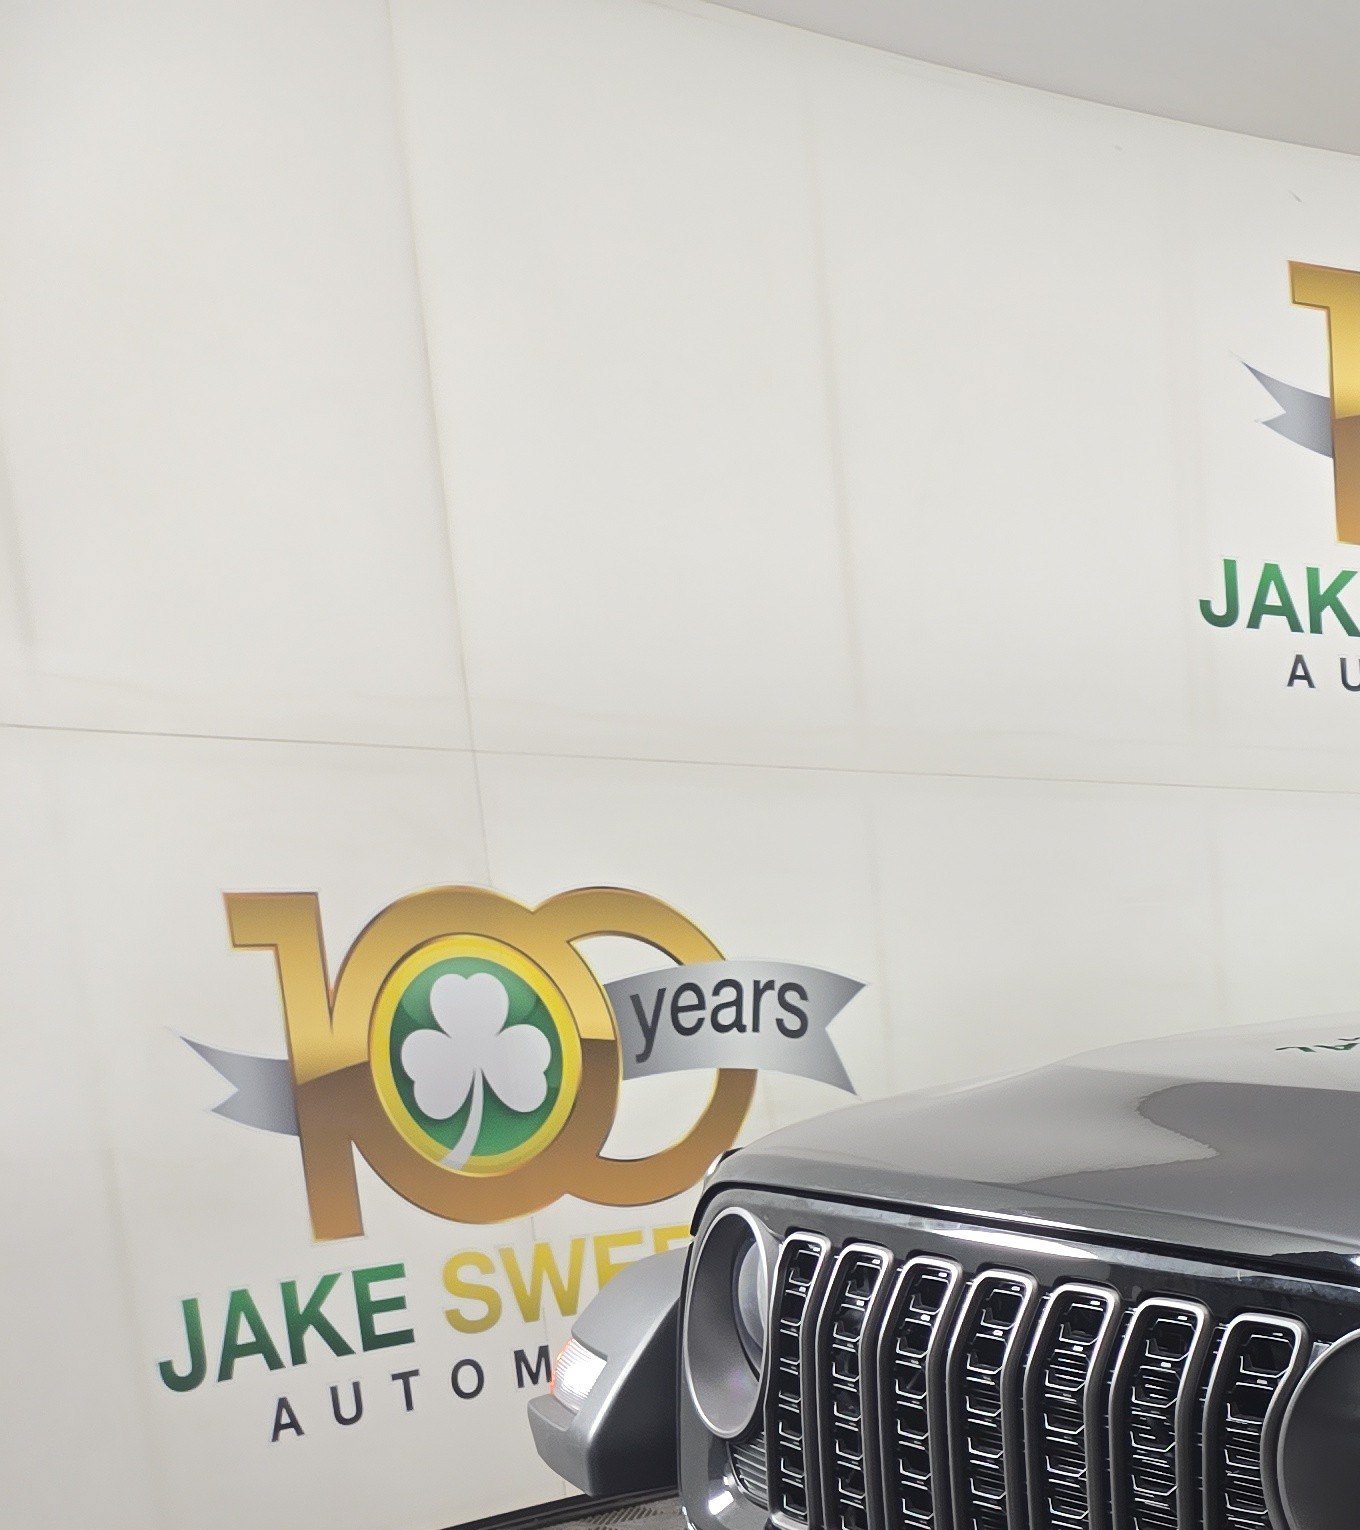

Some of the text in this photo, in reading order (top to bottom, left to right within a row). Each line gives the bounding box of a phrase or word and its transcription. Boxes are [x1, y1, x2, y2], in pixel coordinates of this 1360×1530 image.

[222, 885, 810, 1241] 100 years
[157, 1262, 416, 1393] JAKE
